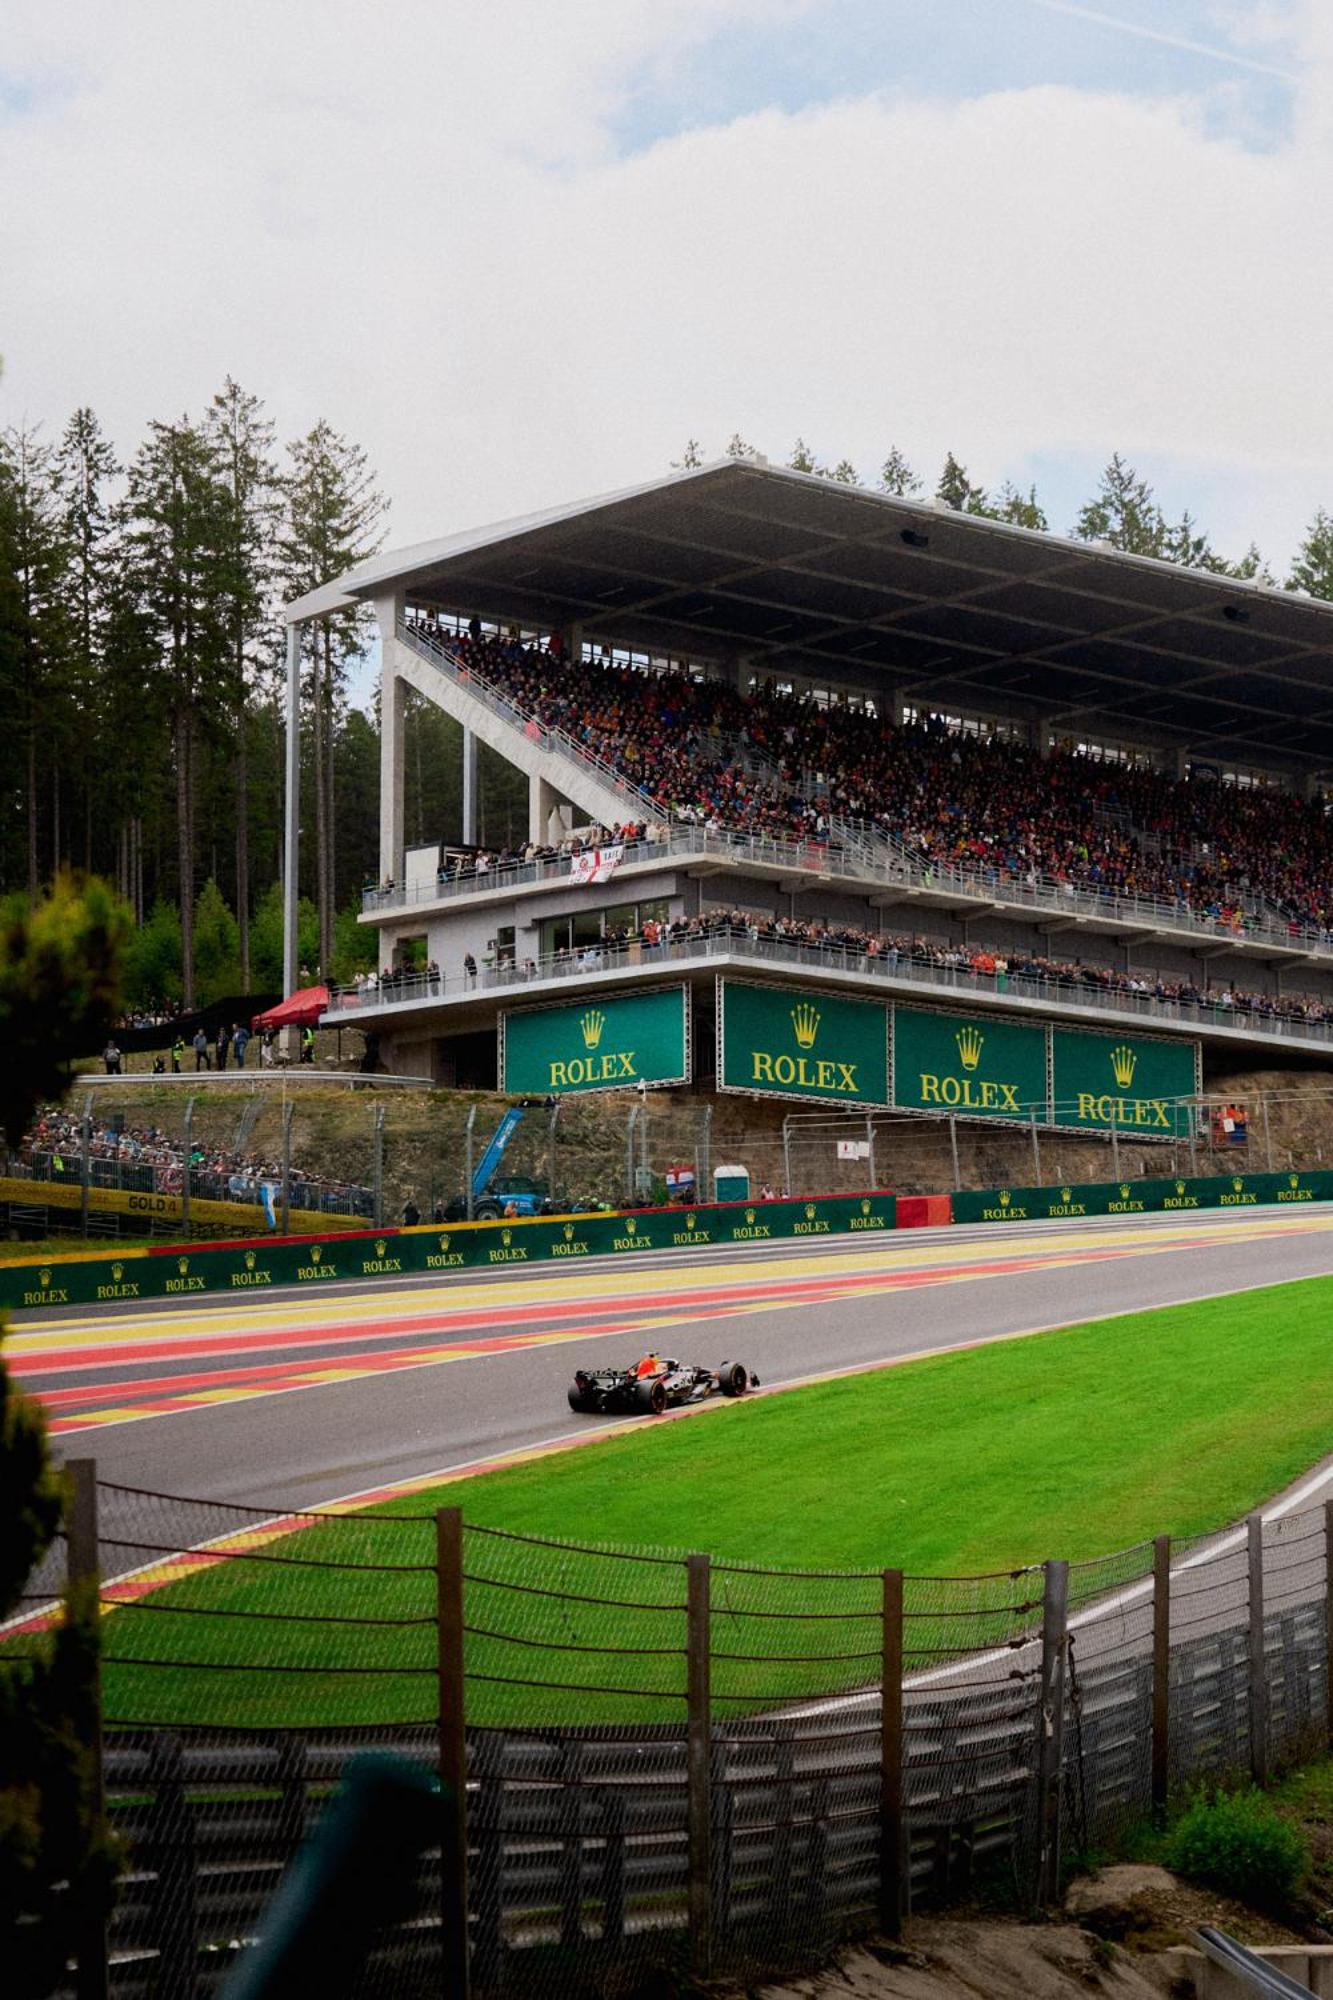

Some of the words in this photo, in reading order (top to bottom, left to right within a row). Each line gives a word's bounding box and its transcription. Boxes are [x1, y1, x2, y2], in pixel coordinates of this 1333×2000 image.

[550, 1052, 637, 1087] ROLEX
[752, 1052, 858, 1092] ROLEX
[920, 1074, 1020, 1111] ROLEX
[1077, 1093, 1170, 1127] ROLEX
[1220, 1193, 1257, 1205] ROLEX
[1277, 1189, 1312, 1201] ROLEX
[129, 1196, 165, 1211] GOLD
[1108, 1201, 1144, 1213] ROLEX
[1164, 1197, 1198, 1209] ROLEX
[983, 1207, 1027, 1220] ROLEX
[1049, 1204, 1086, 1217] ROLEX
[794, 1221, 830, 1234] ROLEX
[850, 1217, 884, 1229] ROLEX
[673, 1231, 710, 1244] ROLEX
[733, 1226, 770, 1239] ROLEX
[552, 1242, 588, 1256] ROLEX
[613, 1236, 652, 1250] ROLEX
[427, 1253, 464, 1267] ROLEX
[490, 1248, 528, 1261] ROLEX
[298, 1264, 336, 1280] ROLEX
[363, 1258, 401, 1273] ROLEX
[166, 1277, 205, 1292] ROLEX
[232, 1271, 272, 1285] ROLEX
[24, 1289, 68, 1304] ROLEX
[98, 1284, 139, 1298] ROLEX
